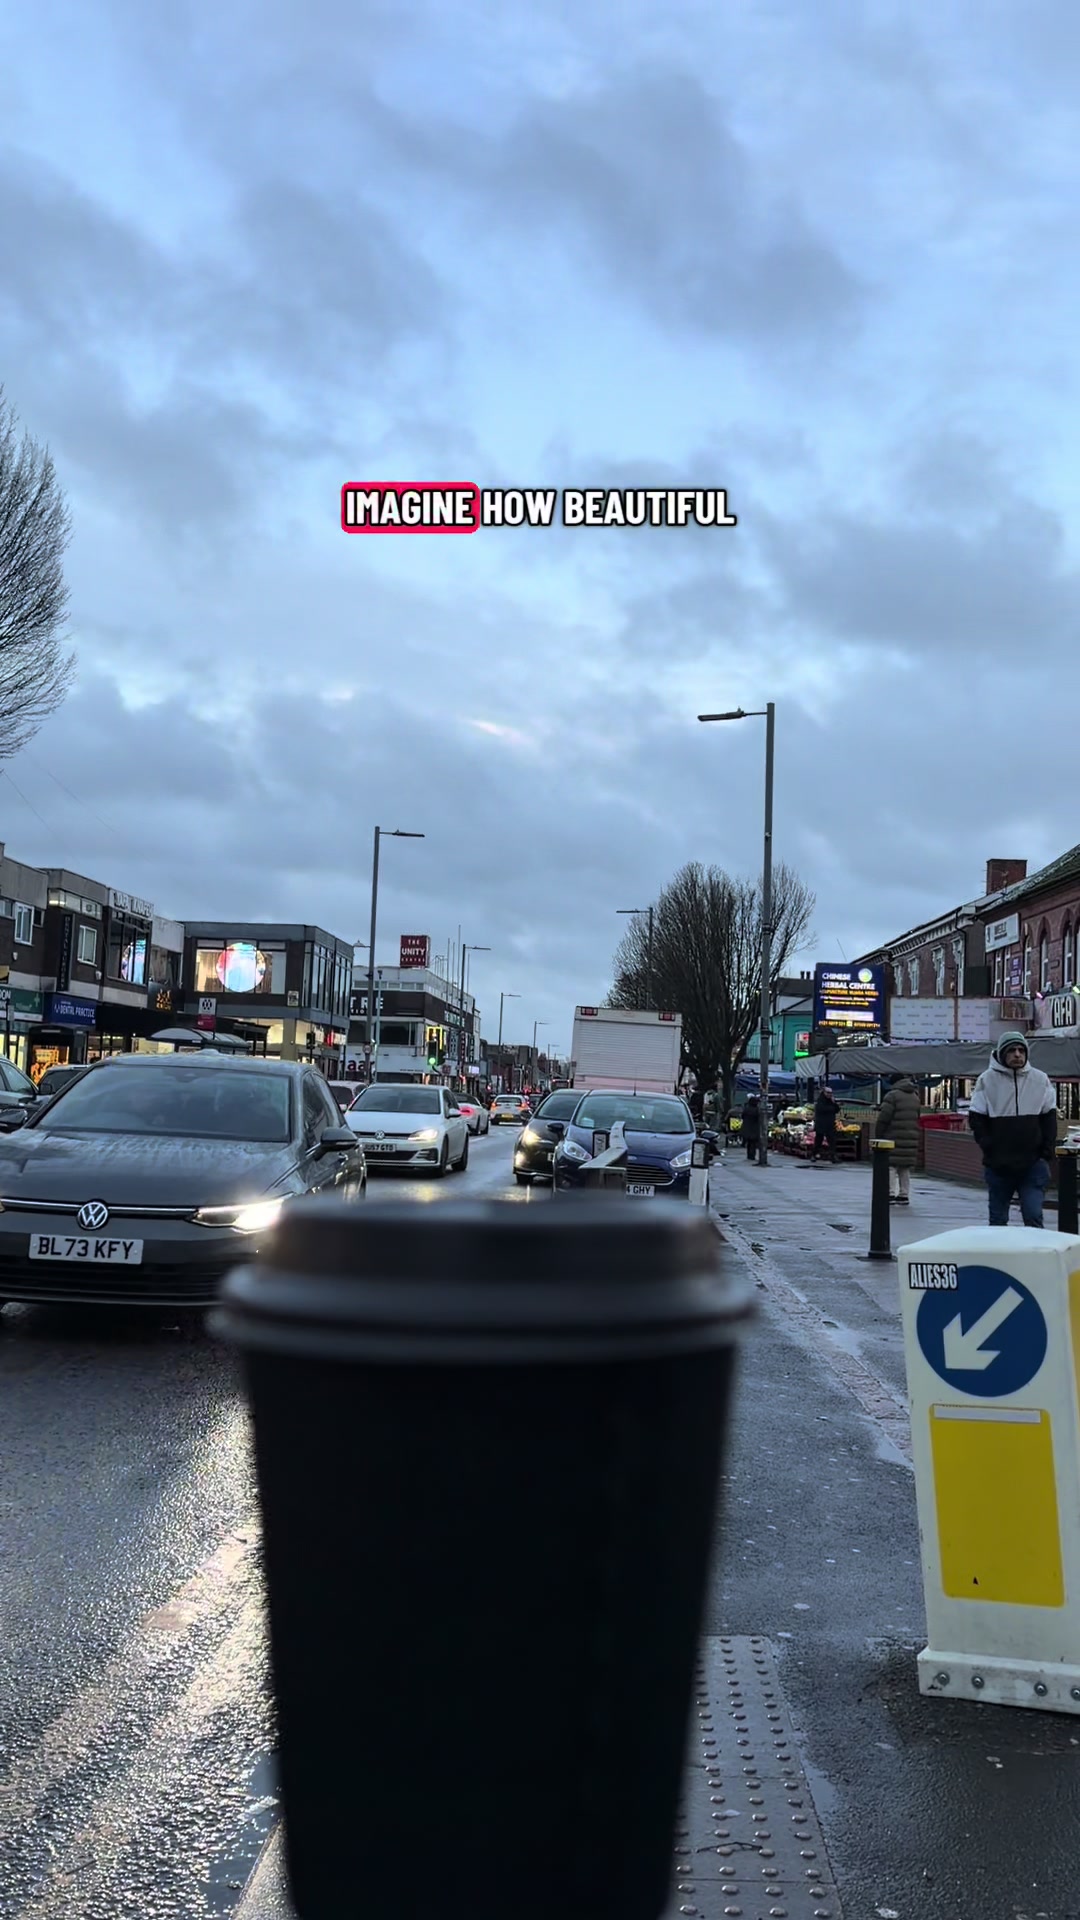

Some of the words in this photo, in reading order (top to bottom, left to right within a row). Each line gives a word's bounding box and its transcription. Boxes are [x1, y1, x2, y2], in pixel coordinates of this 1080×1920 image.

[401, 947, 425, 956] UNITY
[821, 972, 851, 981] CHINESE
[821, 981, 848, 989] HERBAL
[849, 982, 876, 990] CENTRE
[0, 989, 11, 1000] ON
[60, 1004, 75, 1015] DENTAL
[76, 1006, 95, 1018] PRACTICE
[632, 1185, 651, 1195] GHY
[37, 1236, 90, 1257] BL73
[93, 1239, 135, 1260] KFY
[910, 1263, 957, 1289] ALIES36
